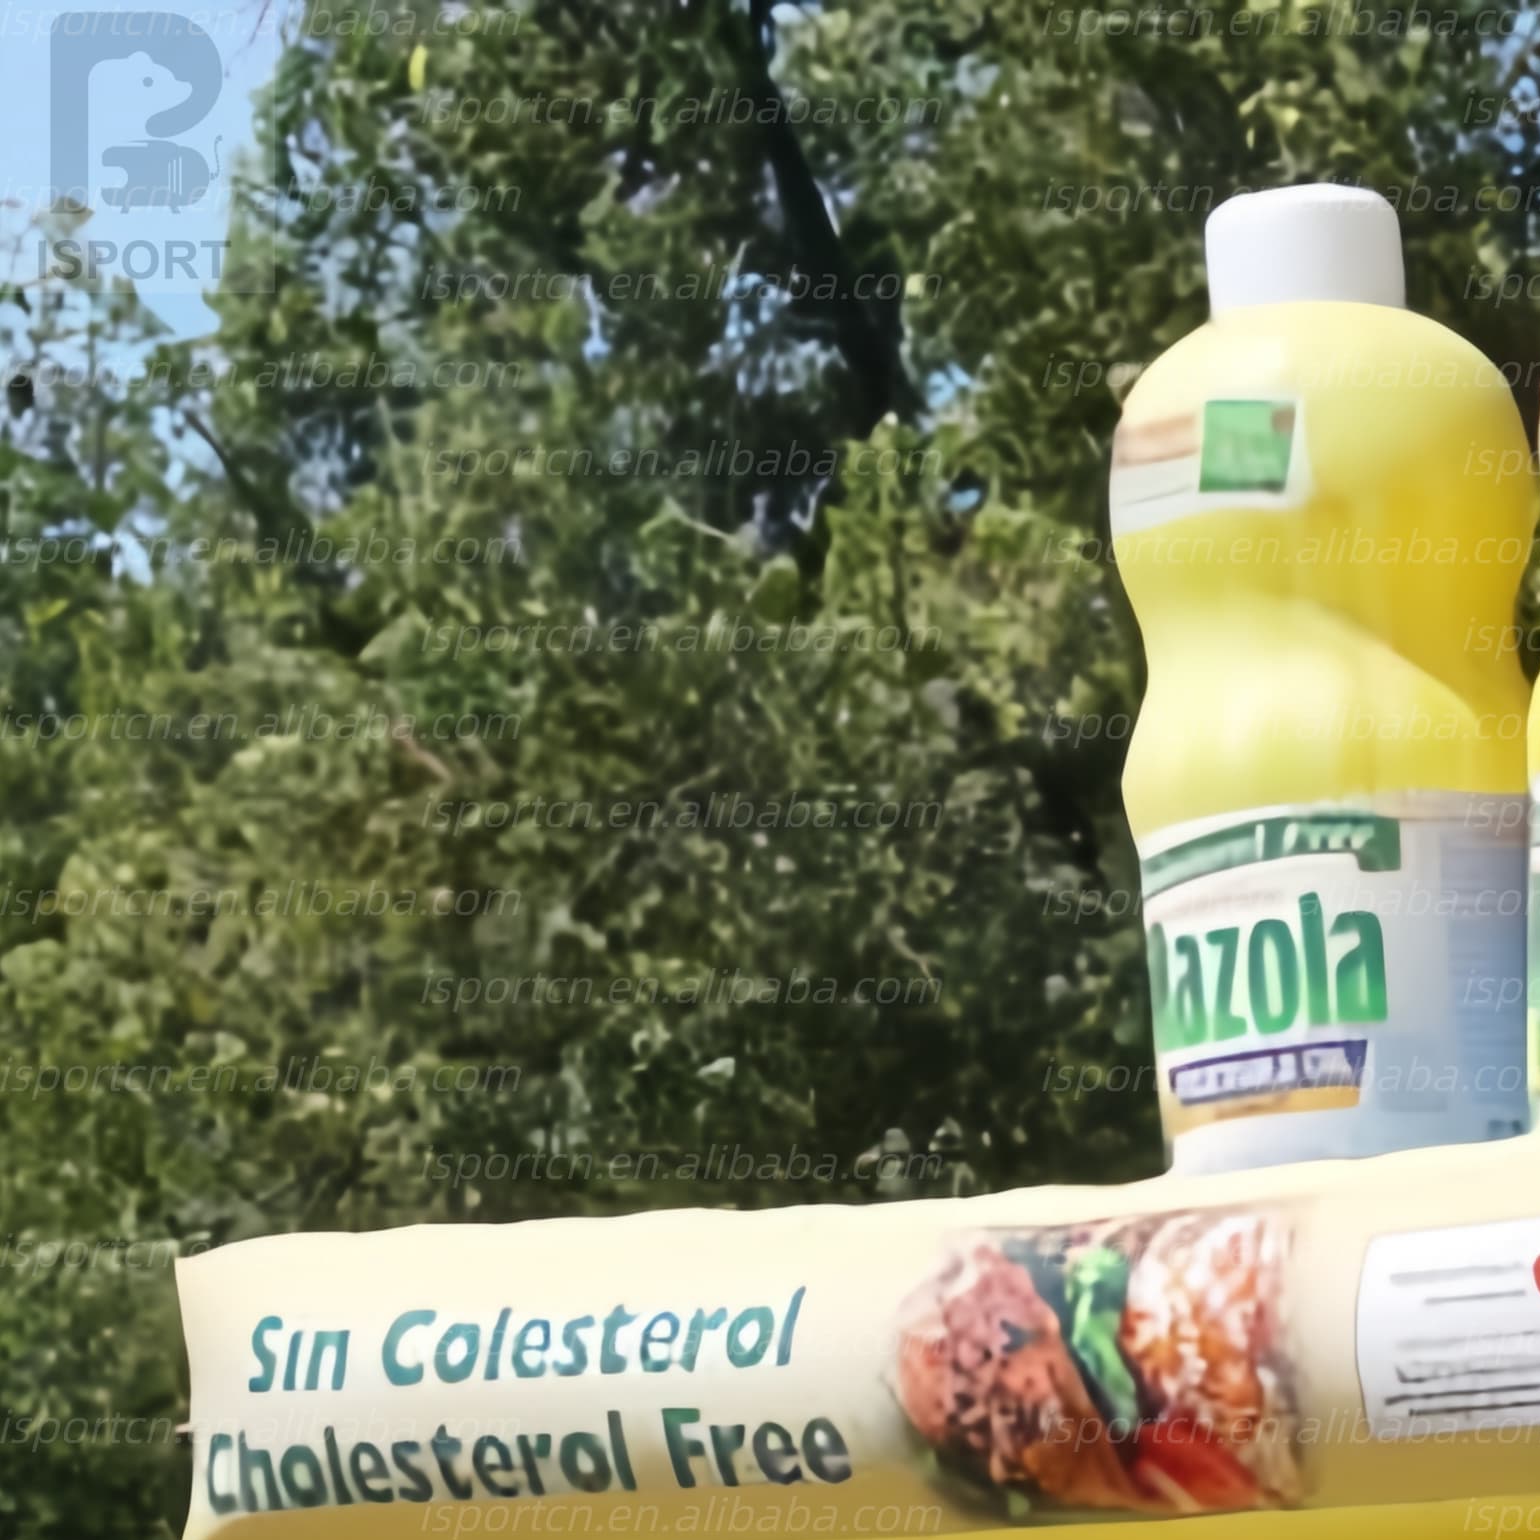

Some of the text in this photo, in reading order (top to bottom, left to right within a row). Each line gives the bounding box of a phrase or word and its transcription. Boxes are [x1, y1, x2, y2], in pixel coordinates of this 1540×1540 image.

[248, 1315, 350, 1394] Sin
[381, 1286, 807, 1388] Colesterol
[207, 1407, 853, 1514] Cholesterol Free
